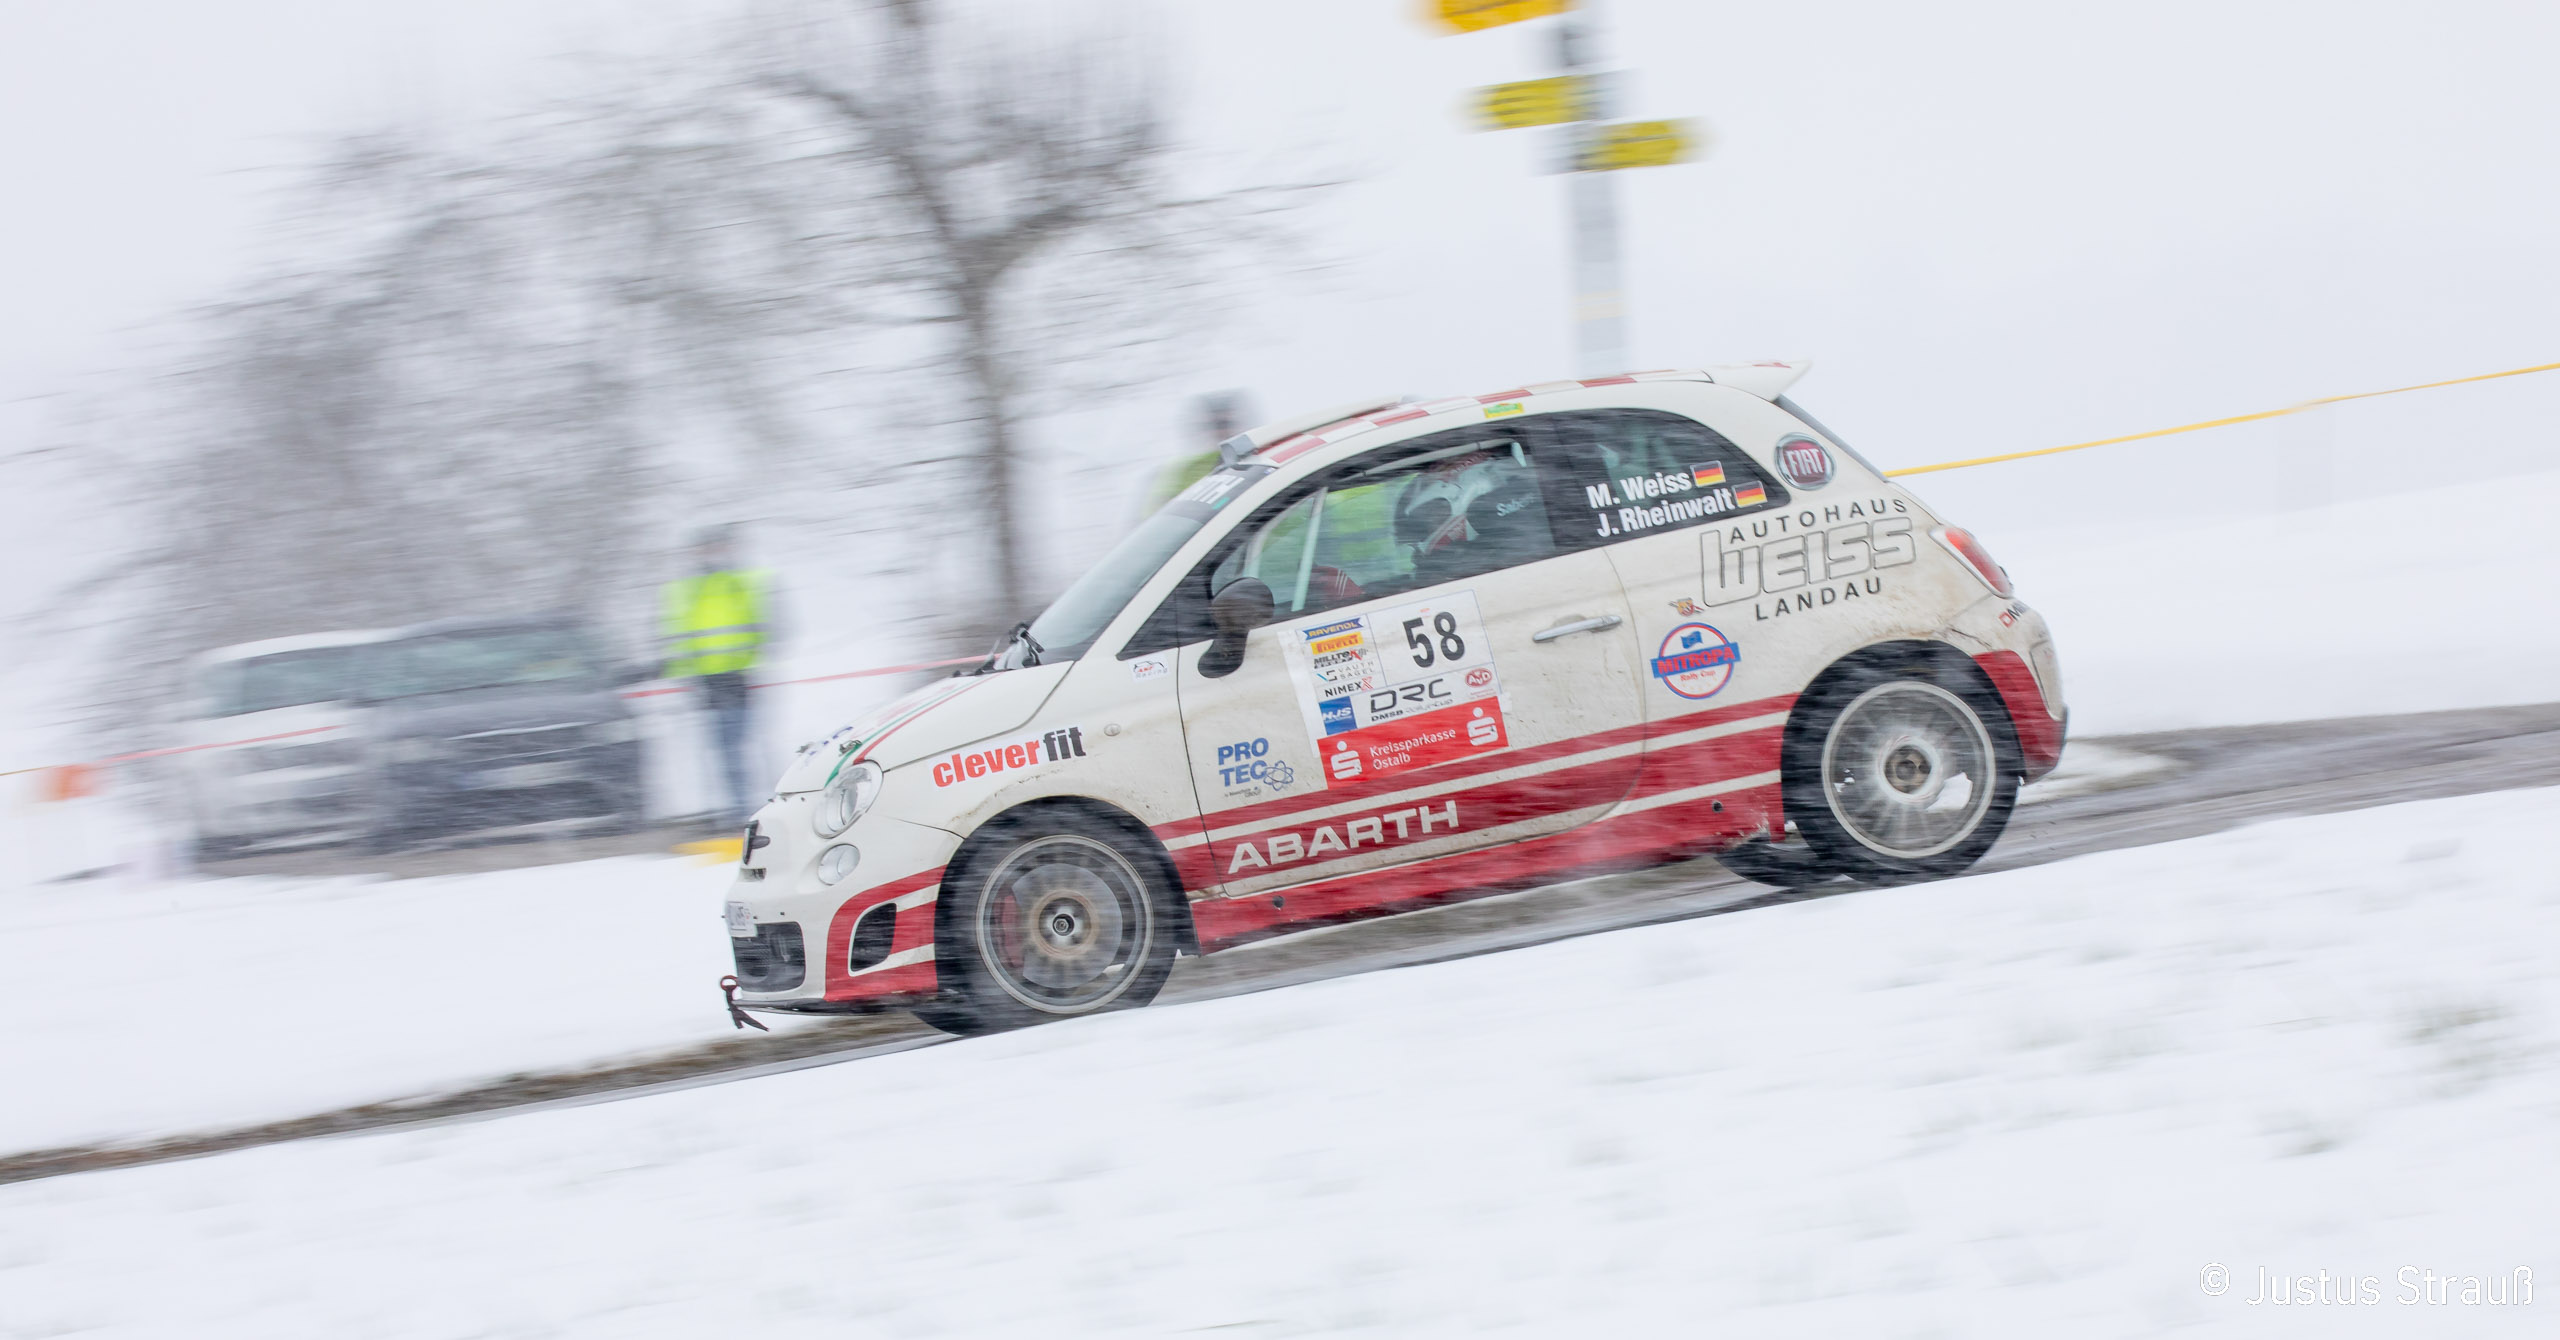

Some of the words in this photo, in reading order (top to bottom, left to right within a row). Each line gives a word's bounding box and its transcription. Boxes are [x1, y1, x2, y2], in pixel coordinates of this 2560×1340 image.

[1785, 449, 1823, 477] FIAT
[1585, 482, 1620, 508] M.
[1620, 471, 1692, 501] Weiss
[1597, 513, 1620, 538] J.
[1618, 487, 1736, 533] Rheinwalt
[1730, 499, 1907, 544] AUTOHAUS
[1700, 516, 1917, 608] WEISS
[1755, 576, 1882, 621] LANDAU
[1307, 621, 1358, 637] RAVENOL
[1316, 634, 1359, 653] PIRELLI
[1402, 611, 1465, 668] 58
[1338, 660, 1374, 672] VAUTH
[1340, 667, 1374, 680] SAGEL
[1656, 646, 1736, 675] MITROPA
[1370, 678, 1452, 713] DRC
[1217, 737, 1269, 766] PRO
[1369, 729, 1457, 757] Kreissparkasse
[1219, 759, 1268, 787] TEC
[1372, 754, 1411, 770] Ostalb
[1227, 800, 1459, 874] ABARTH
